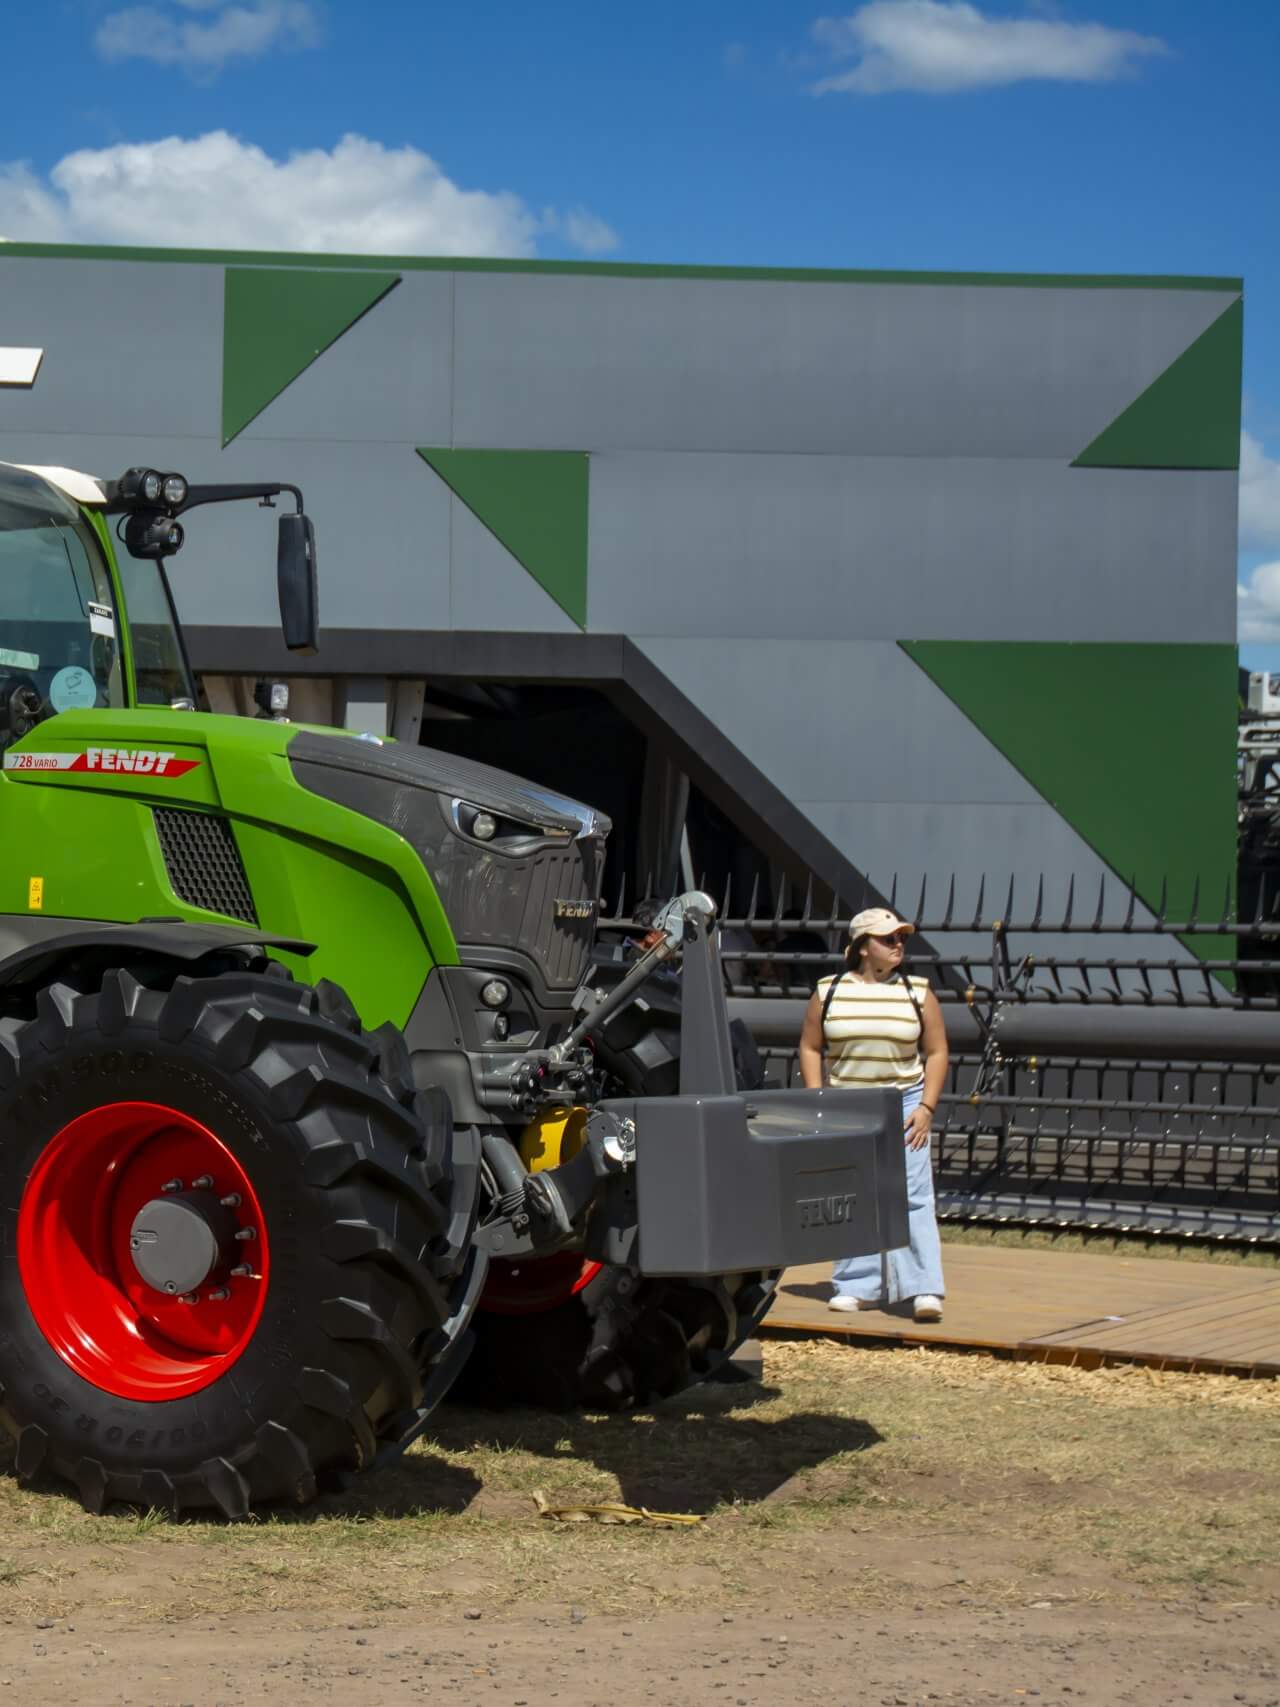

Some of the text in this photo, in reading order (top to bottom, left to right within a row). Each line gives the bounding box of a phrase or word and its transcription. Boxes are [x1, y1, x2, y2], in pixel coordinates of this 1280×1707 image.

[12, 747, 176, 774] 728 VARIO FENDT
[796, 1192, 857, 1228] FENDT
